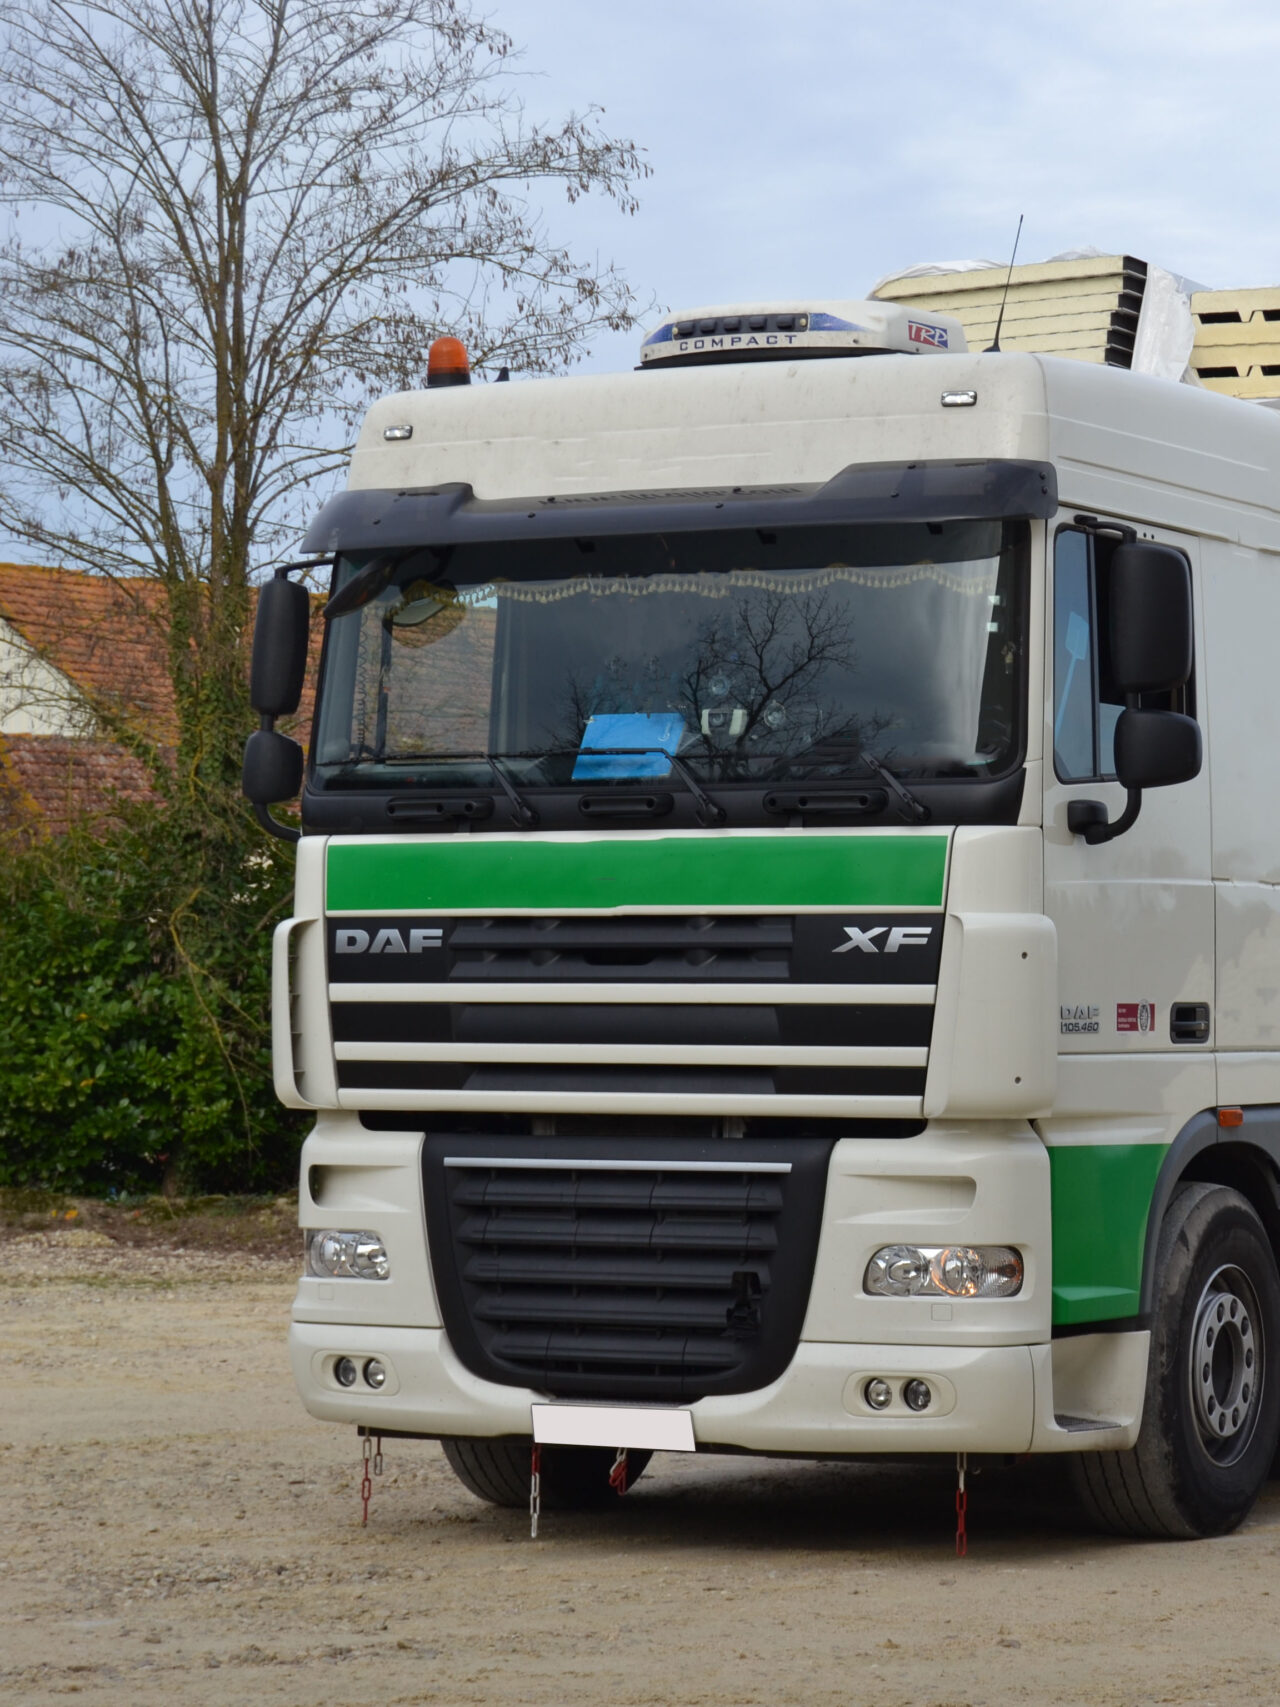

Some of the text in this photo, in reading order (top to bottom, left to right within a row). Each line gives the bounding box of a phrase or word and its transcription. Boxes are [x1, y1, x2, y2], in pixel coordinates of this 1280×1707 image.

[680, 335, 797, 351] COMPACT
[908, 322, 949, 350] TRP
[335, 928, 443, 953] DAF
[832, 927, 932, 953] XF
[1060, 1005, 1099, 1020] DAF
